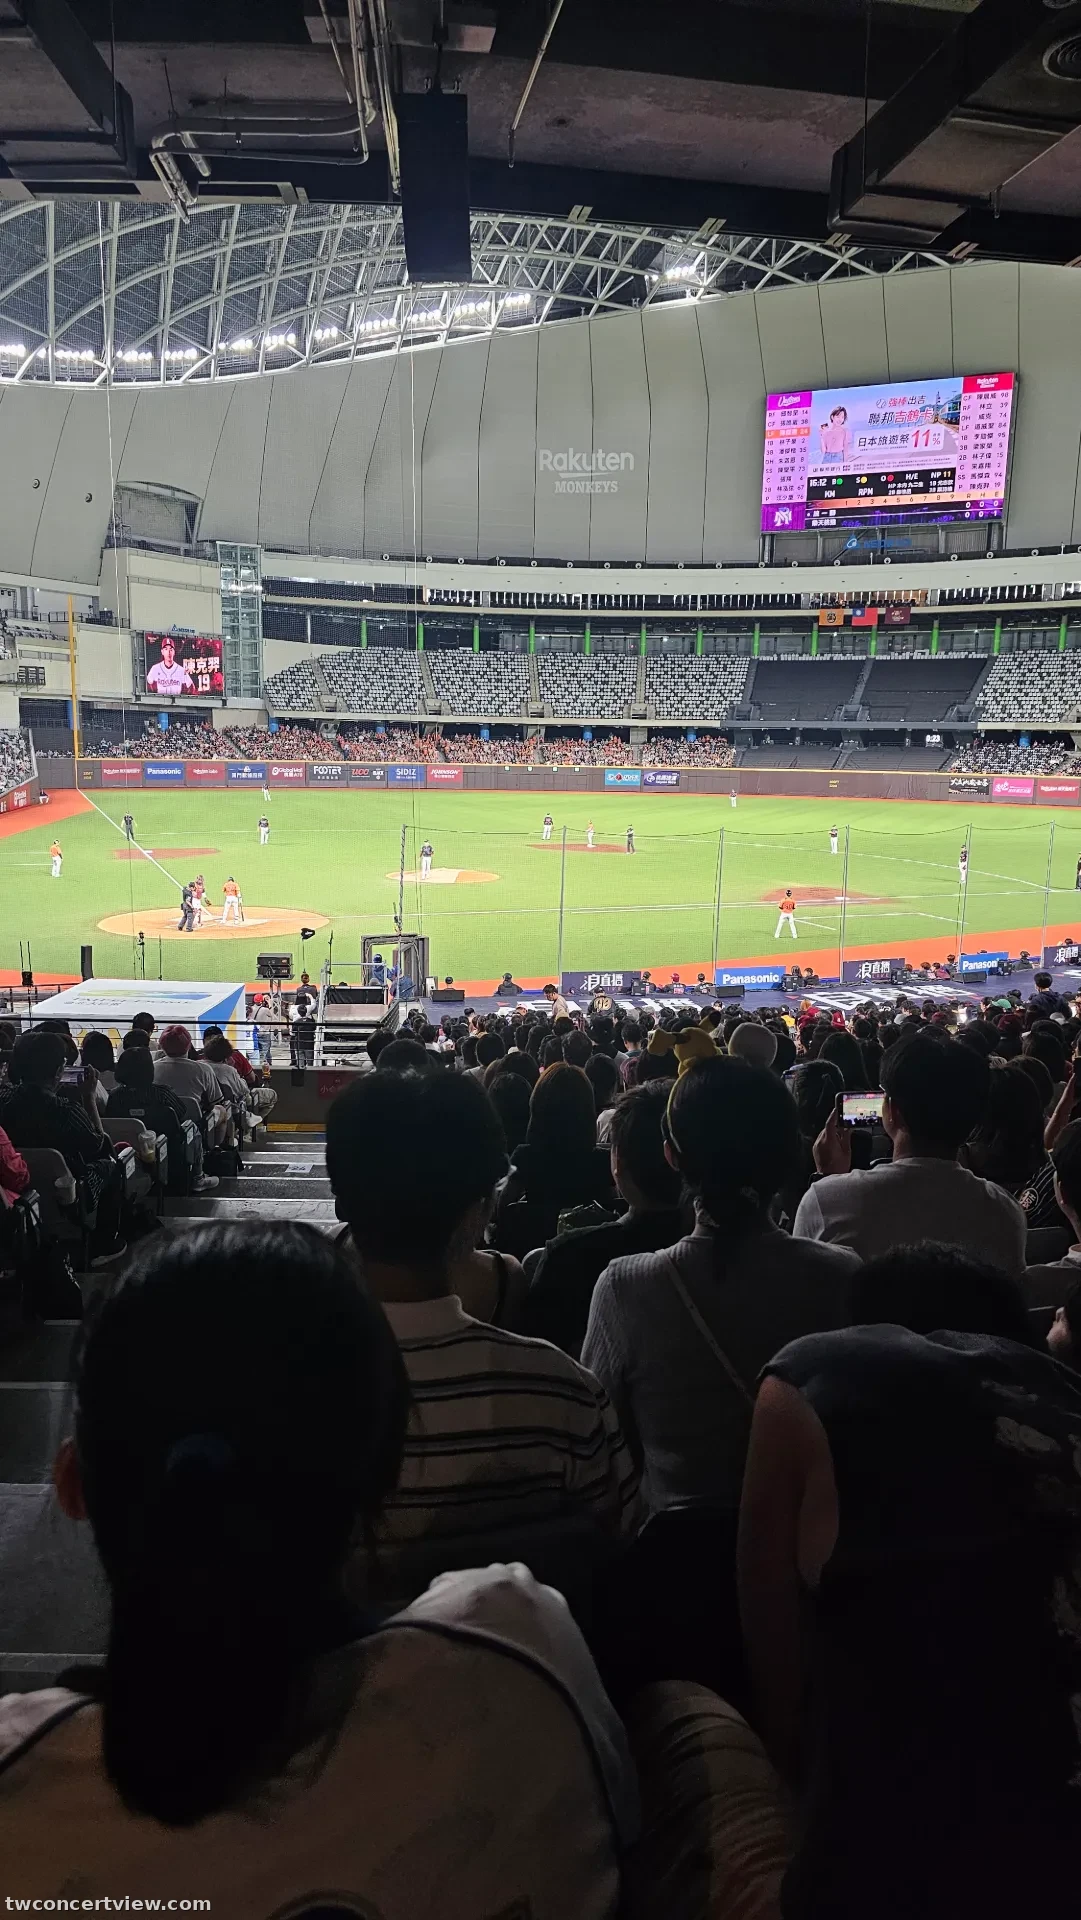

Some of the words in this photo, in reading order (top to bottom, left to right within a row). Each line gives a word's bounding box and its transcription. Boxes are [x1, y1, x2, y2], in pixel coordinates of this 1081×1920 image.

[868, 407, 934, 426] 聯邦吉鶴卡
[858, 434, 910, 447] 日本旅遊祭
[912, 429, 931, 448] 11
[540, 448, 634, 471] Rakuten
[554, 481, 618, 493] MONKEYS
[810, 478, 827, 487] 16:12
[183, 657, 220, 674] 陳克羿
[198, 674, 210, 692] 19
[314, 766, 342, 775] FOOTER
[855, 961, 890, 979] 浪直播
[962, 958, 999, 970] Panason
[580, 973, 623, 991] 浪直播
[722, 972, 780, 984] Panasonic
